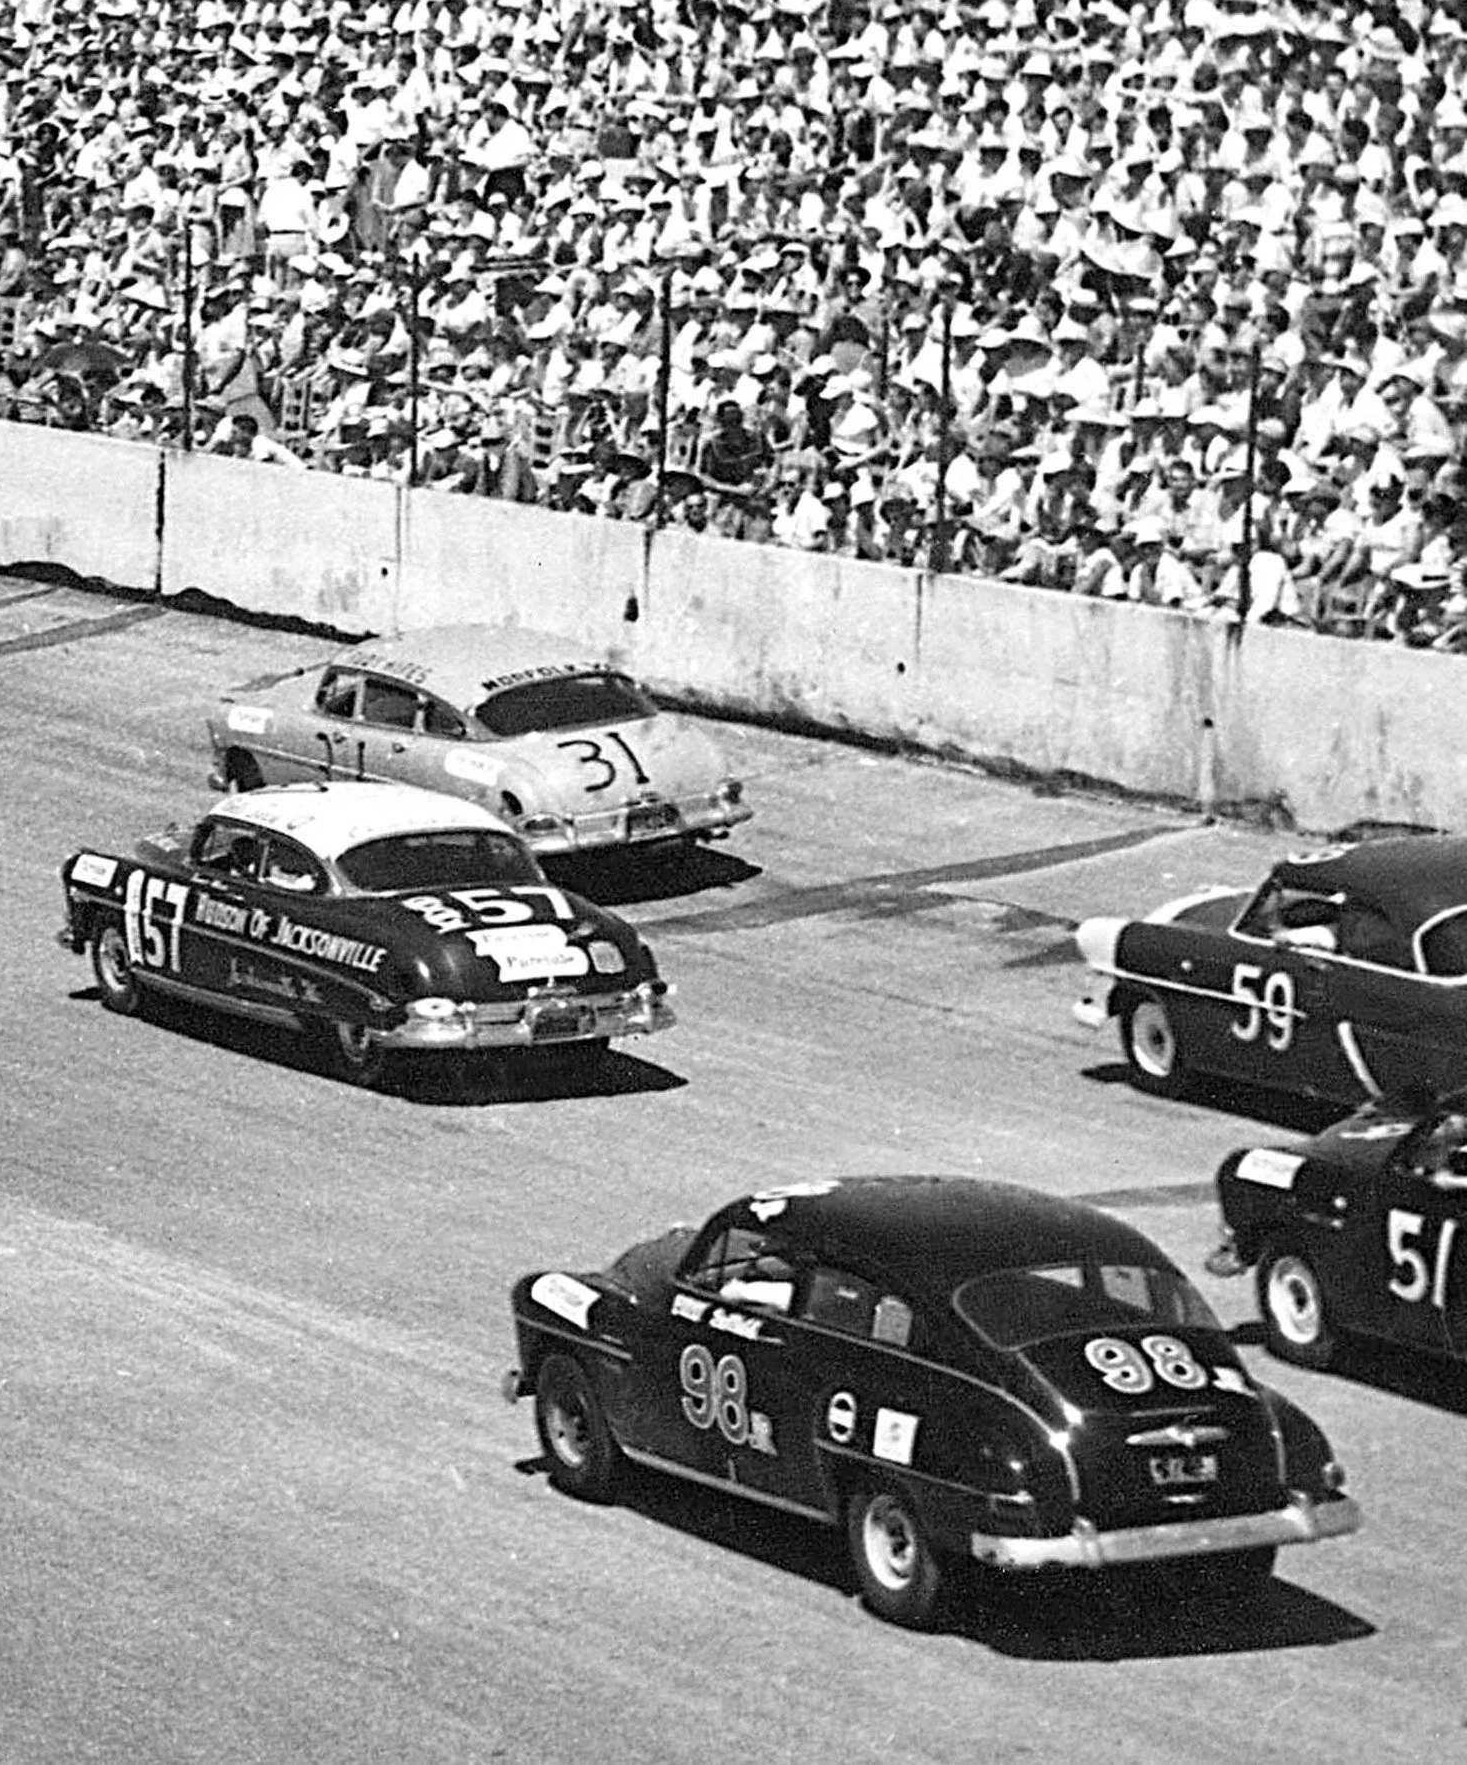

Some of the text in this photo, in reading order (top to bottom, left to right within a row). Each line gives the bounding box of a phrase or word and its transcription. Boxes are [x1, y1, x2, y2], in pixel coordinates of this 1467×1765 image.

[558, 732, 649, 793] 31
[448, 885, 575, 924] 57
[270, 915, 388, 973] JACKSONVILLE
[1231, 963, 1295, 1050] 59
[1388, 1207, 1458, 1309] 51
[679, 1344, 749, 1444] 98
[1084, 1335, 1209, 1394] 98
